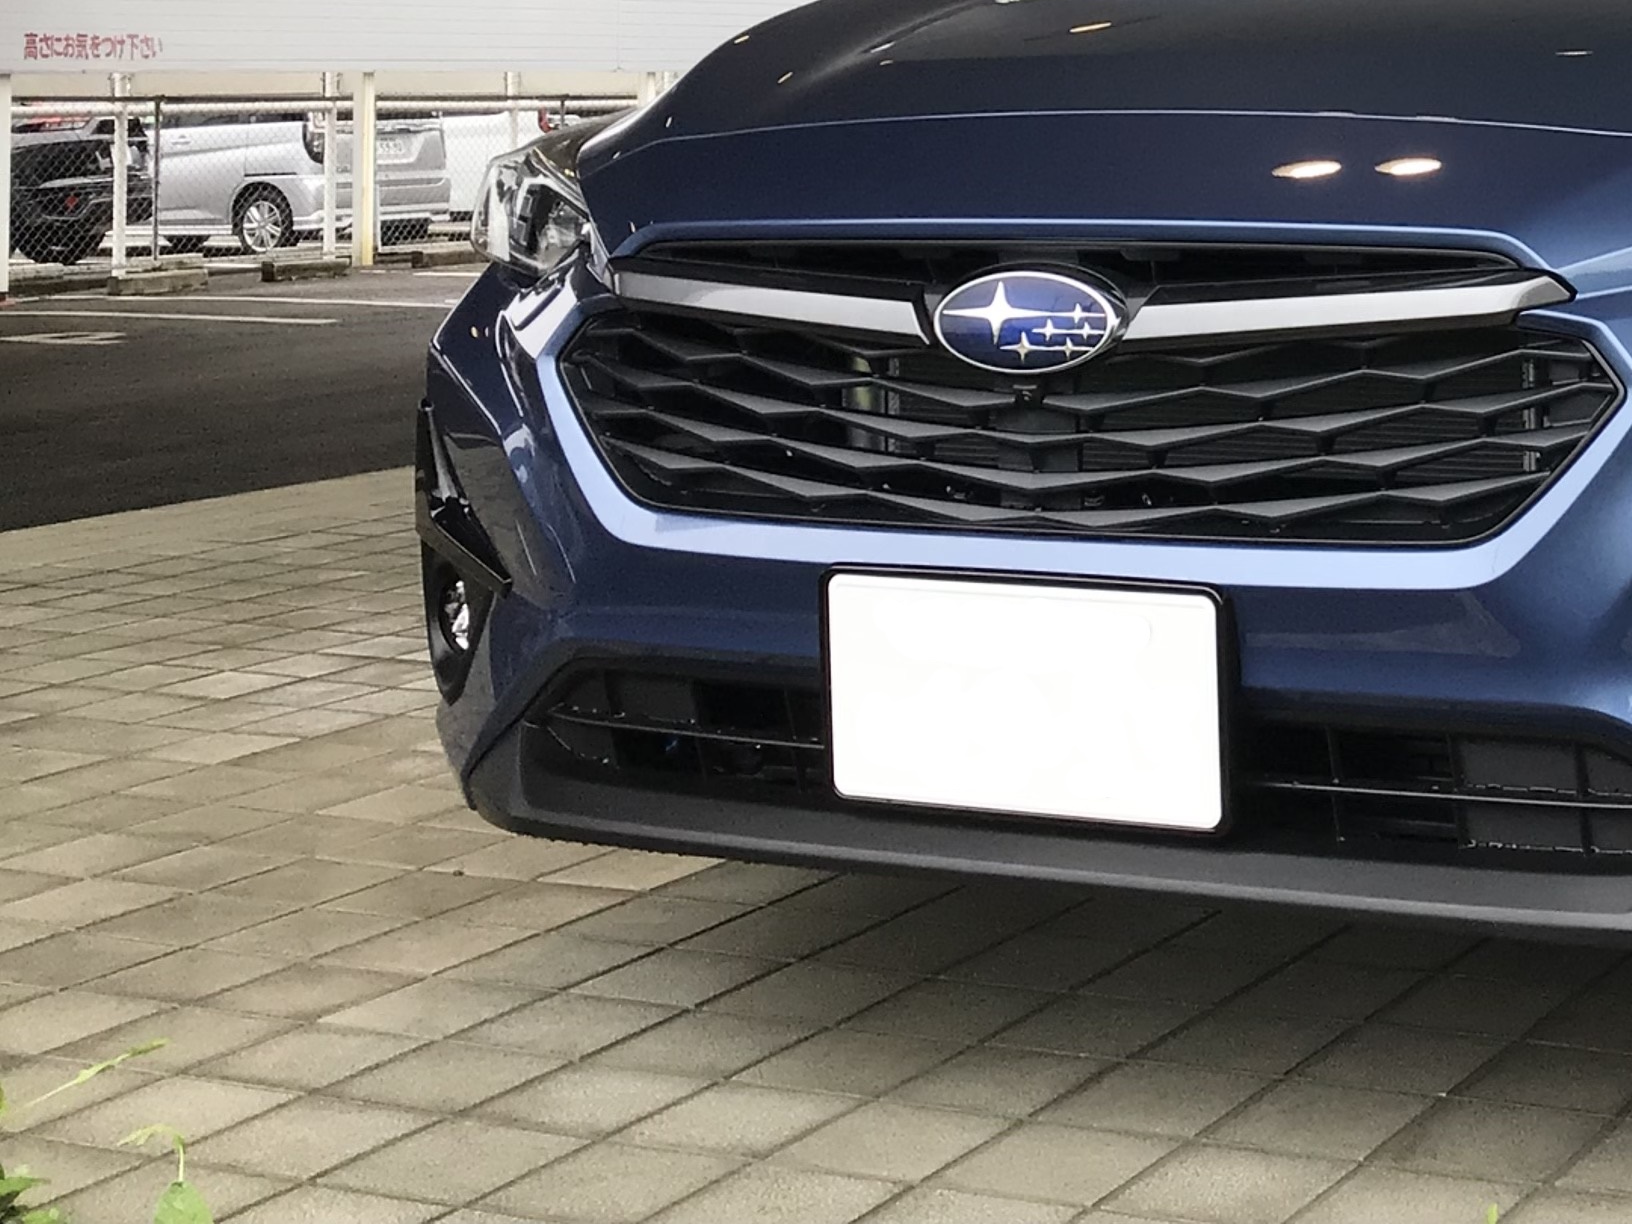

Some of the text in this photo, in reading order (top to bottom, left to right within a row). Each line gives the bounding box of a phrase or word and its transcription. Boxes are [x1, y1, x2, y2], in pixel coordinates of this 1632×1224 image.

[23, 32, 164, 60] 高さにお気をつけ下さい
